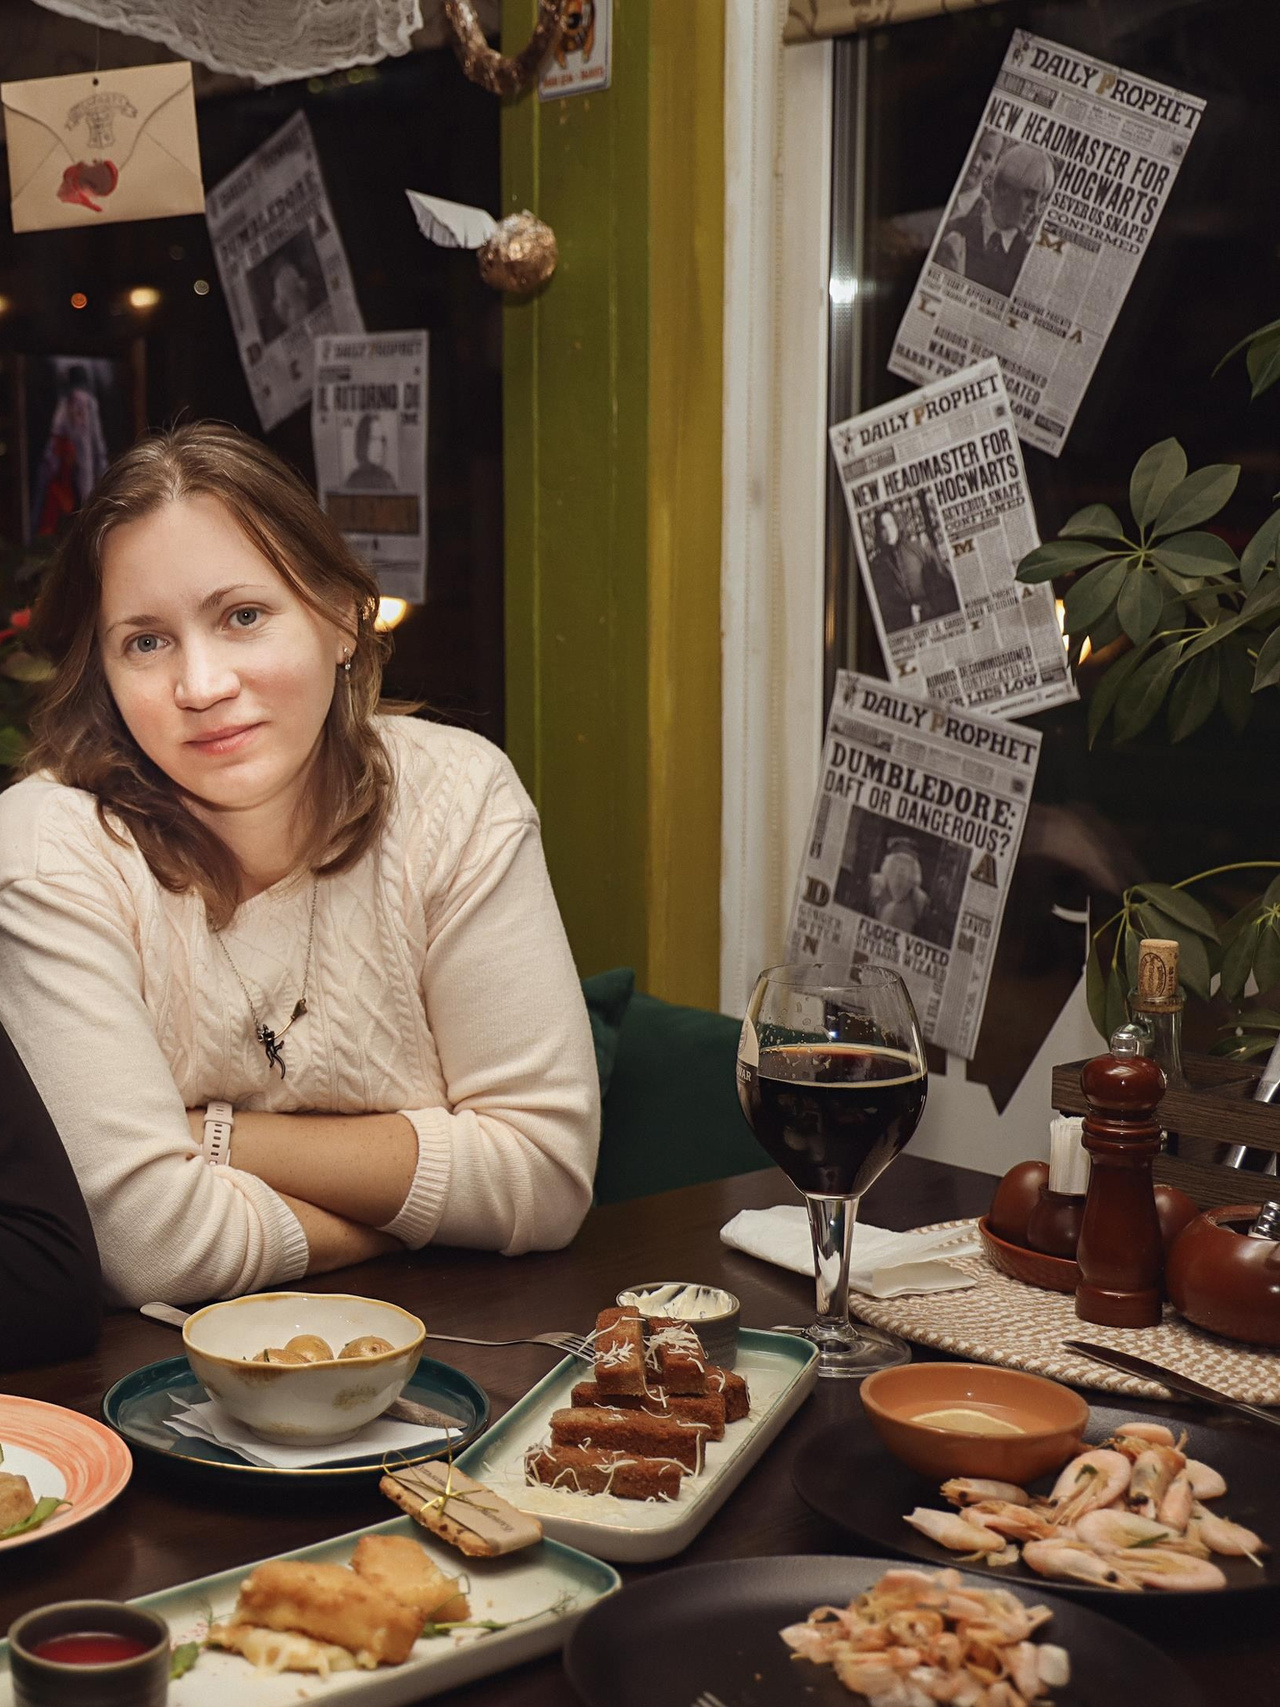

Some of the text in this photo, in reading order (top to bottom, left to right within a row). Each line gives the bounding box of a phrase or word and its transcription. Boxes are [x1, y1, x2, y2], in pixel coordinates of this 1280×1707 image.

[1029, 46, 1099, 91] DAILY
[1094, 70, 1203, 132] PROPHET
[984, 96, 1023, 134] NEW
[1021, 111, 1132, 179] HEADMASTER
[1129, 156, 1171, 195] FOR
[1050, 190, 1105, 226] SEVERUS
[1102, 212, 1148, 245] SNAPE
[1057, 160, 1160, 227] HOGWARTS
[1046, 207, 1141, 256] CONFIRMED
[926, 338, 967, 368] WANDS
[859, 411, 911, 447] DAILY
[910, 371, 1001, 427] PROPHET
[850, 478, 883, 510] NEW
[882, 436, 980, 501] HEADMASTER
[980, 426, 1013, 460] FOR
[933, 450, 1019, 509] HOGWARTS
[941, 479, 1022, 523] SEVERUS SNAPE
[945, 492, 1025, 535] CONFIRMED
[1003, 670, 1038, 696] LOW
[860, 689, 928, 729] DAILY
[929, 711, 1037, 765] PROPHET
[823, 768, 1010, 859] DAFT OR DANGEROUS?
[829, 741, 1018, 832] DUMBLEDORE:
[858, 916, 949, 968] FUDGE VOTED
